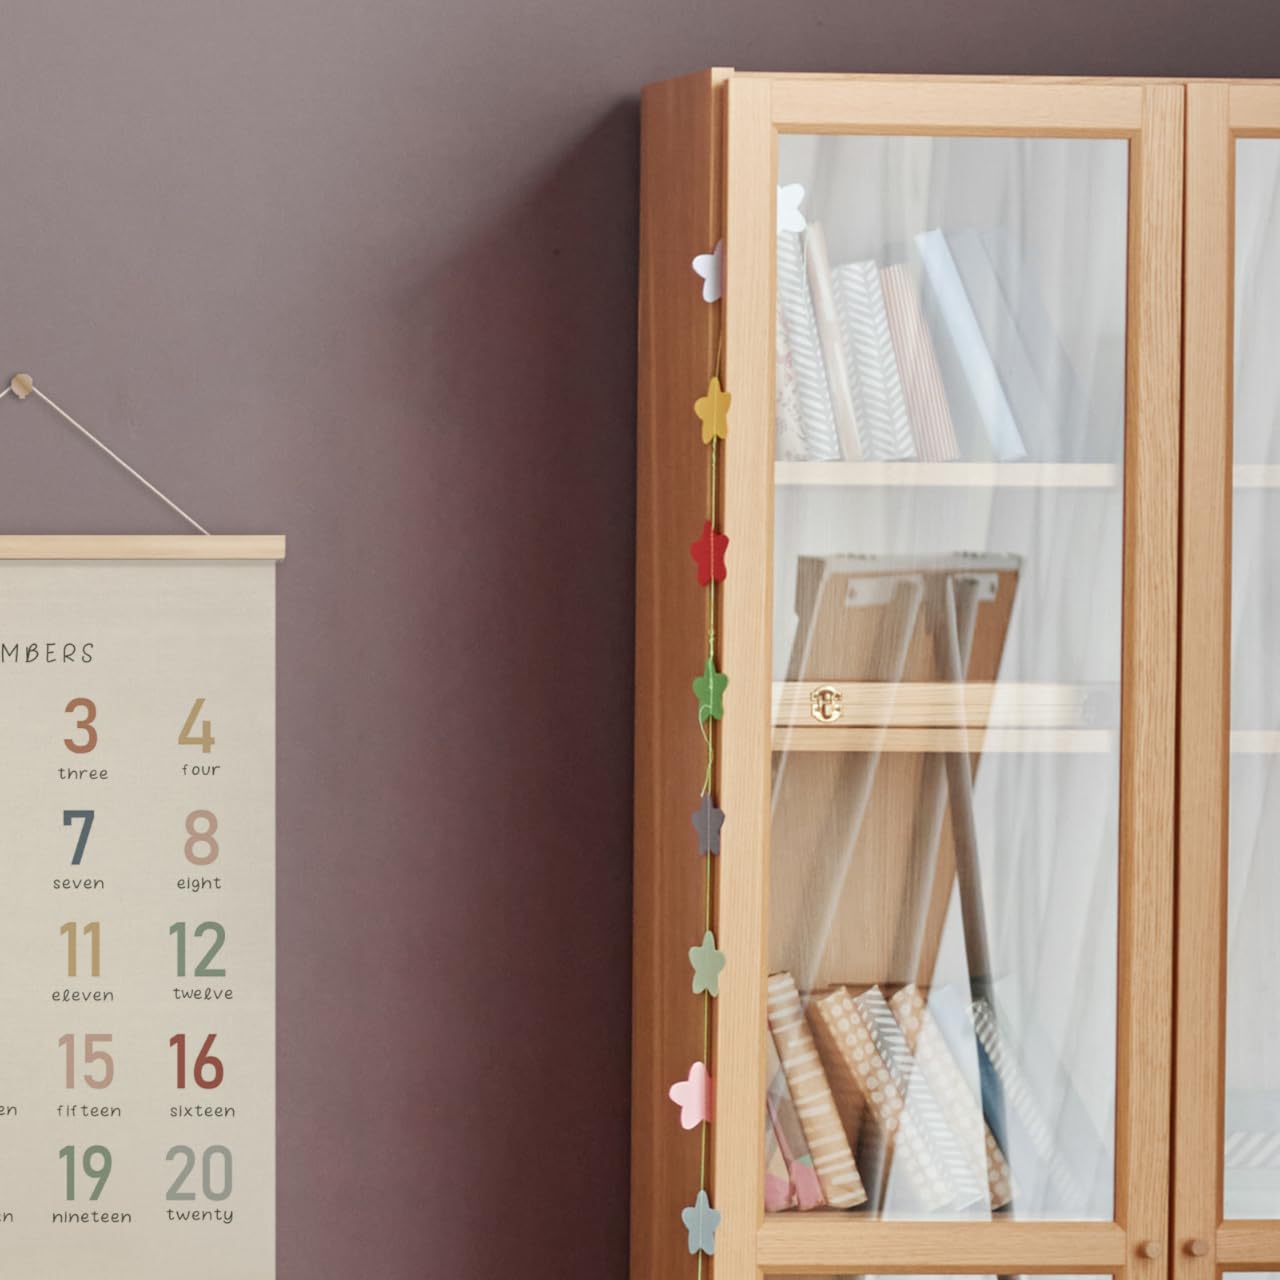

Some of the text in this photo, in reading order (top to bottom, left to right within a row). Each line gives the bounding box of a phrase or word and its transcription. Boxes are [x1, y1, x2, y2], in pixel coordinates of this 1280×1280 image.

[64, 697, 97, 754] 3
[178, 698, 215, 753] 4
[57, 767, 109, 780] three
[181, 763, 221, 776] four
[63, 810, 95, 865] 7
[185, 810, 219, 865] 8
[52, 878, 105, 890] seven
[176, 876, 222, 893] eight
[60, 922, 100, 976] 11
[170, 921, 226, 977] 12
[51, 988, 114, 1003] eleven
[172, 986, 233, 1001] twelve
[59, 1034, 113, 1089] 15
[170, 1034, 224, 1089] 16
[56, 1104, 121, 1118] fifteen
[169, 1104, 236, 1118] sixteen
[59, 1145, 112, 1200] 19
[166, 1146, 232, 1201] 20
[52, 1210, 132, 1224] nineteen
[165, 1207, 234, 1225] twenty
